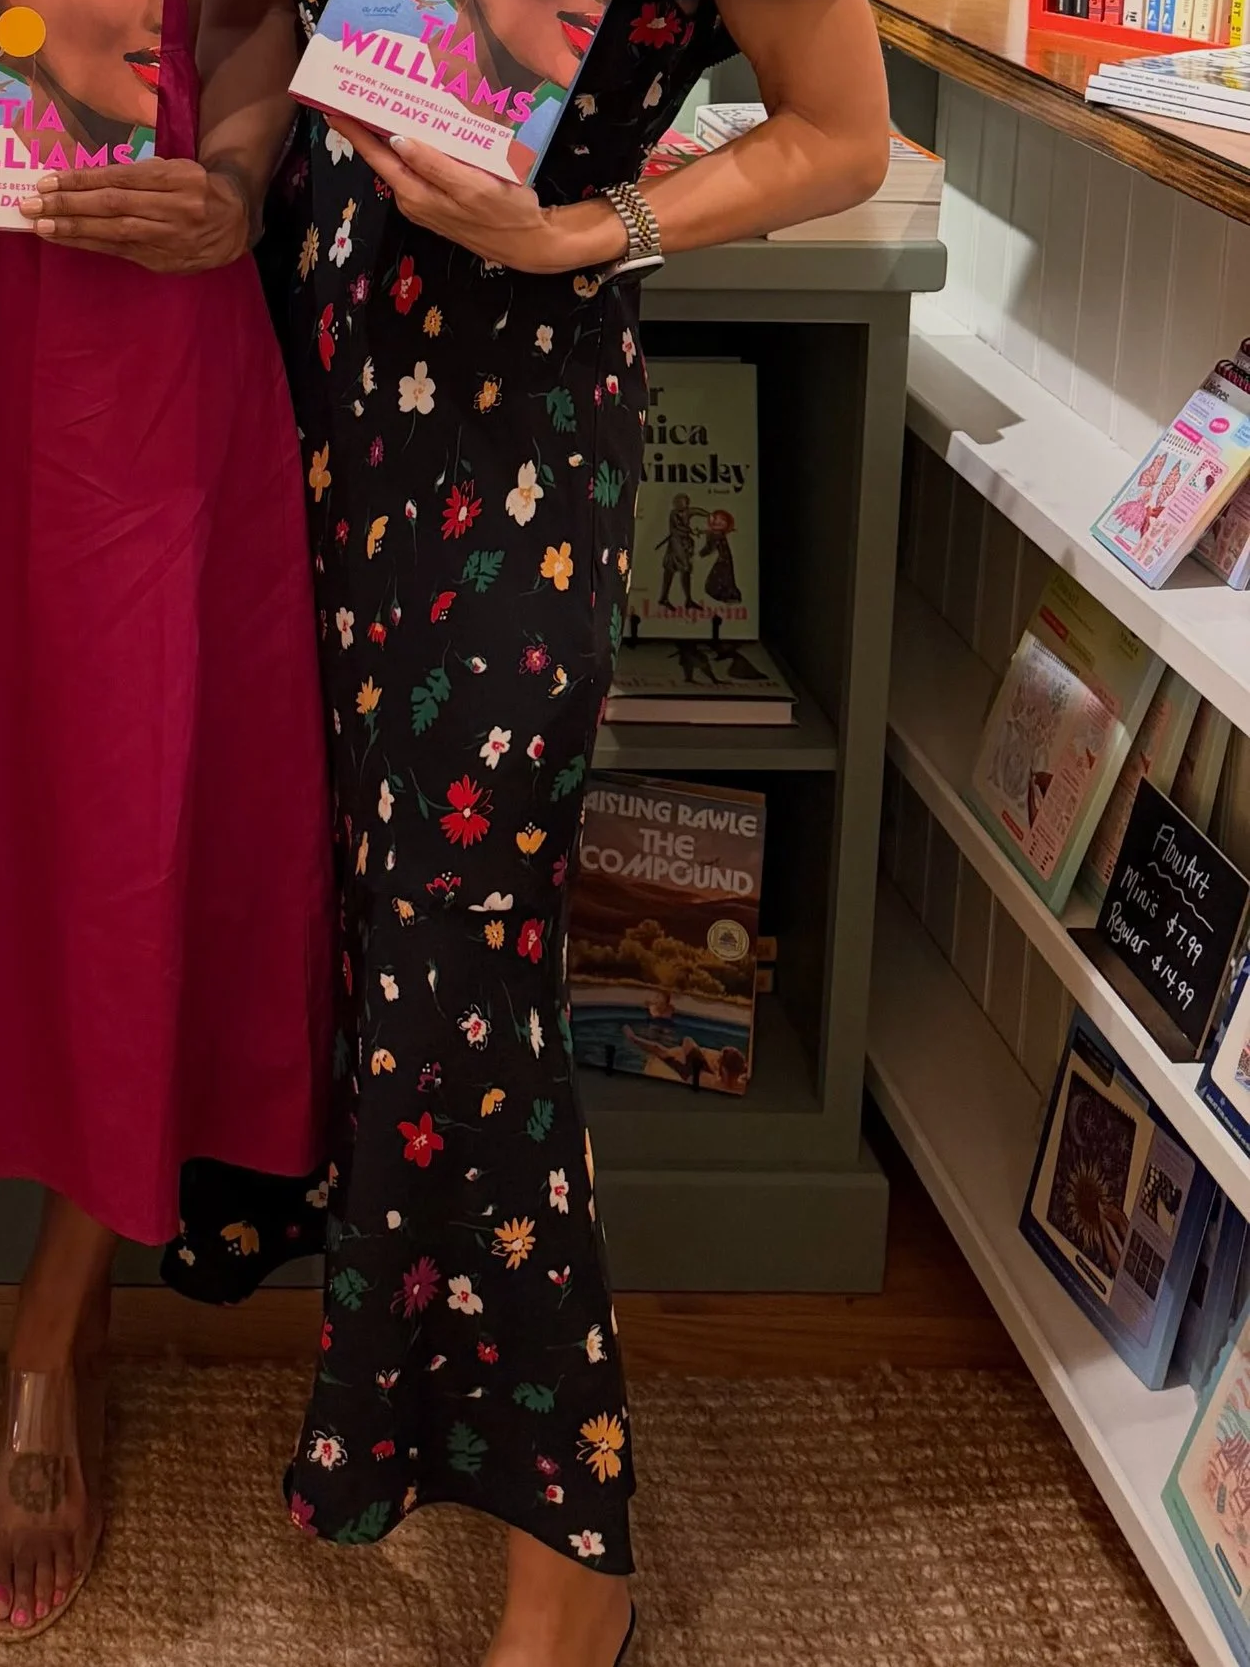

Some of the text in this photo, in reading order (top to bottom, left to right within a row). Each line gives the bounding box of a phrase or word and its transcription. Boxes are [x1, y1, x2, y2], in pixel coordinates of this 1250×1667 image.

[420, 13, 477, 65] TIA
[340, 22, 536, 124] WILLIAMS
[337, 80, 496, 151] SEVEN JUNE
[639, 828, 696, 859] THE
[677, 804, 758, 837] RAWLE
[579, 846, 753, 895] COMPOUND
[1107, 901, 1195, 1011] Regular $14.99
[1166, 912, 1203, 966] $7.99
